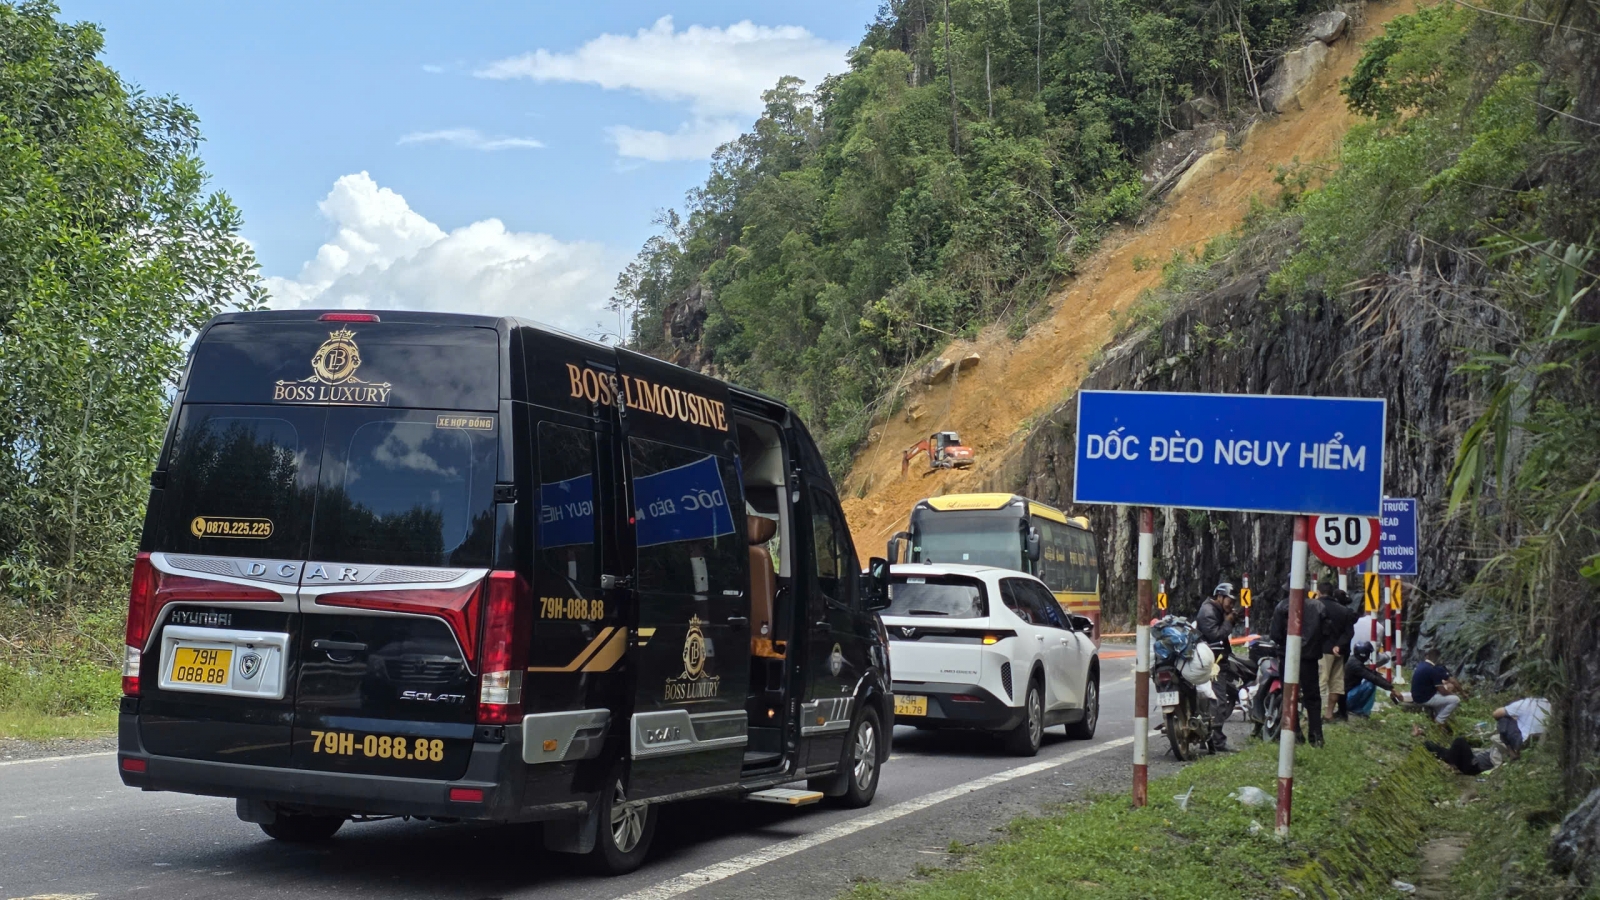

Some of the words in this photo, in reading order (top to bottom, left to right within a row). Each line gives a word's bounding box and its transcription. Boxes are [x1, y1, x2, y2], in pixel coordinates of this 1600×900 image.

[273, 385, 315, 400] BOSS
[318, 386, 391, 402] LUXURY
[621, 374, 728, 432] LIMOUSINE
[439, 418, 450, 427] XE
[1086, 426, 1140, 461] DỐC
[1149, 430, 1203, 463] ĐÈO
[1214, 439, 1291, 467] NGUY
[1299, 431, 1366, 472] HIỂM
[206, 521, 271, 535] 0879.225.225
[1324, 516, 1361, 546] 50
[1379, 517, 1399, 527] HEAD
[246, 562, 359, 582] DCAR
[540, 596, 604, 620] 79H-088.88
[171, 611, 232, 626] HYUNDAI
[192, 650, 218, 666] 79H
[177, 666, 225, 684] 088.88
[400, 690, 466, 703] SOLATI
[664, 684, 685, 700] BOSS
[687, 681, 720, 698] LUXURY
[310, 730, 444, 762] 79H-088.88
